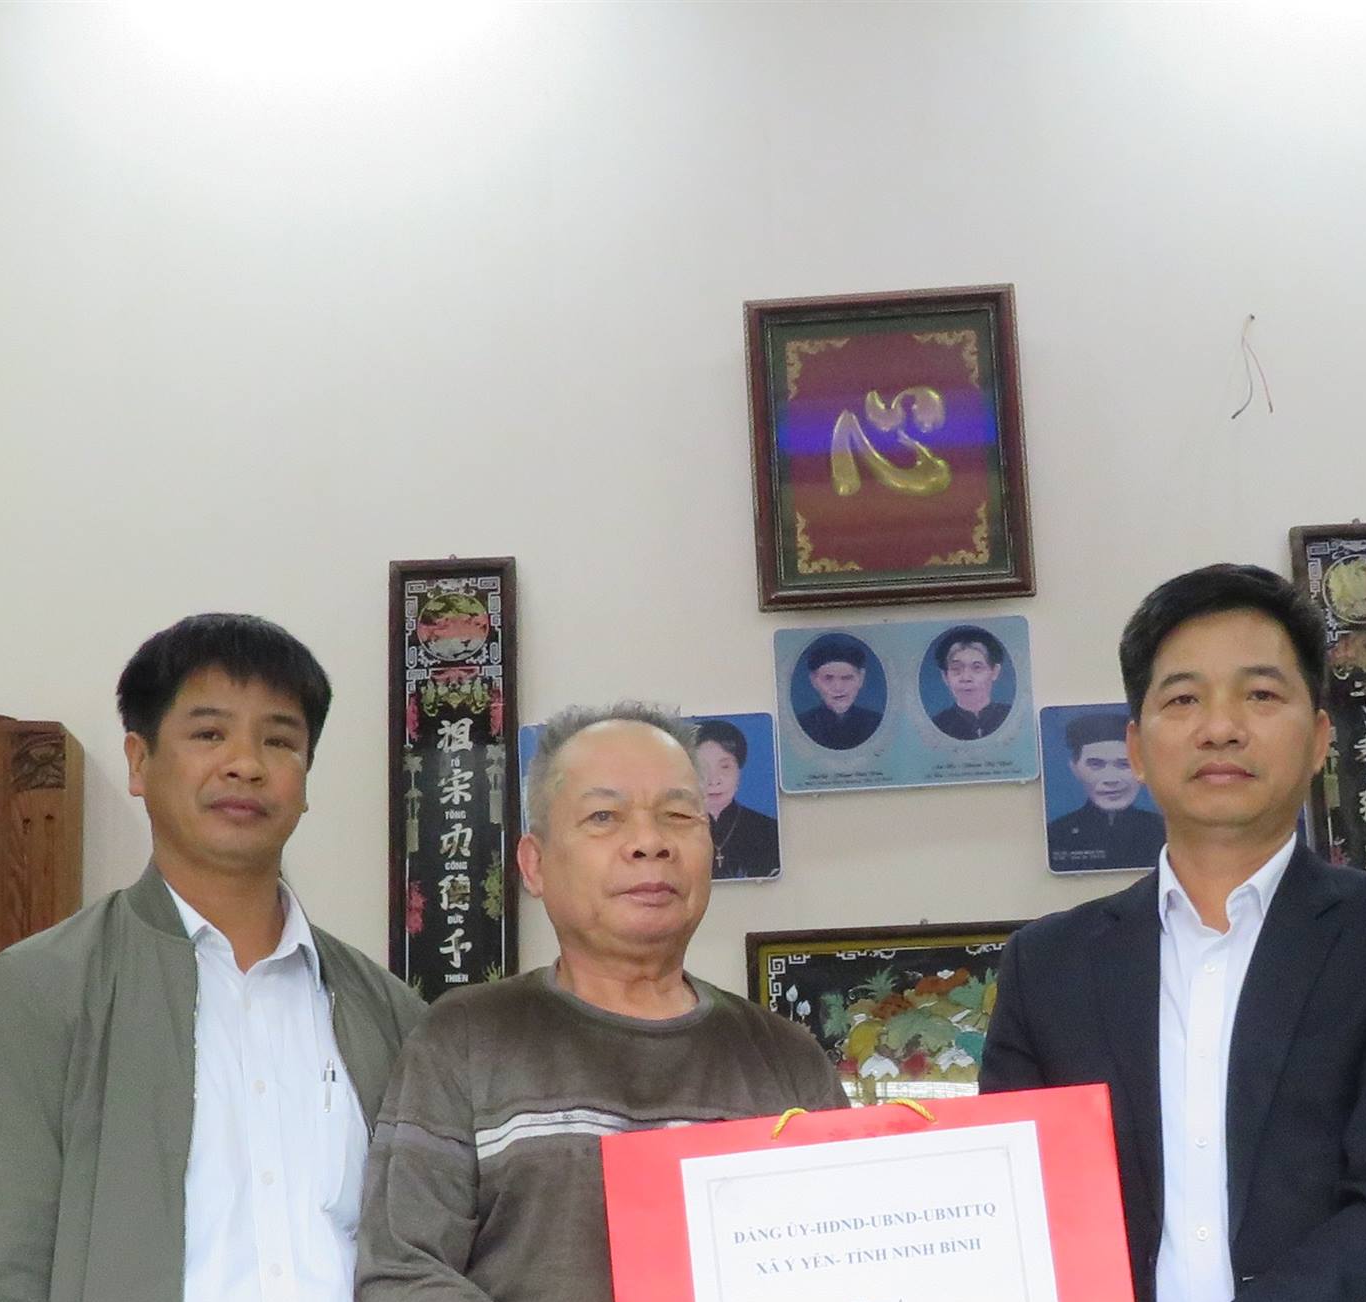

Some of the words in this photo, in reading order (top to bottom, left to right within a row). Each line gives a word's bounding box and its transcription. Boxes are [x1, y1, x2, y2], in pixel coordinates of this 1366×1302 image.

[756, 1257, 780, 1276] XÃ
[784, 1255, 795, 1272] Ý
[892, 1242, 935, 1260] NINH
[940, 1236, 982, 1254] BÌNH
